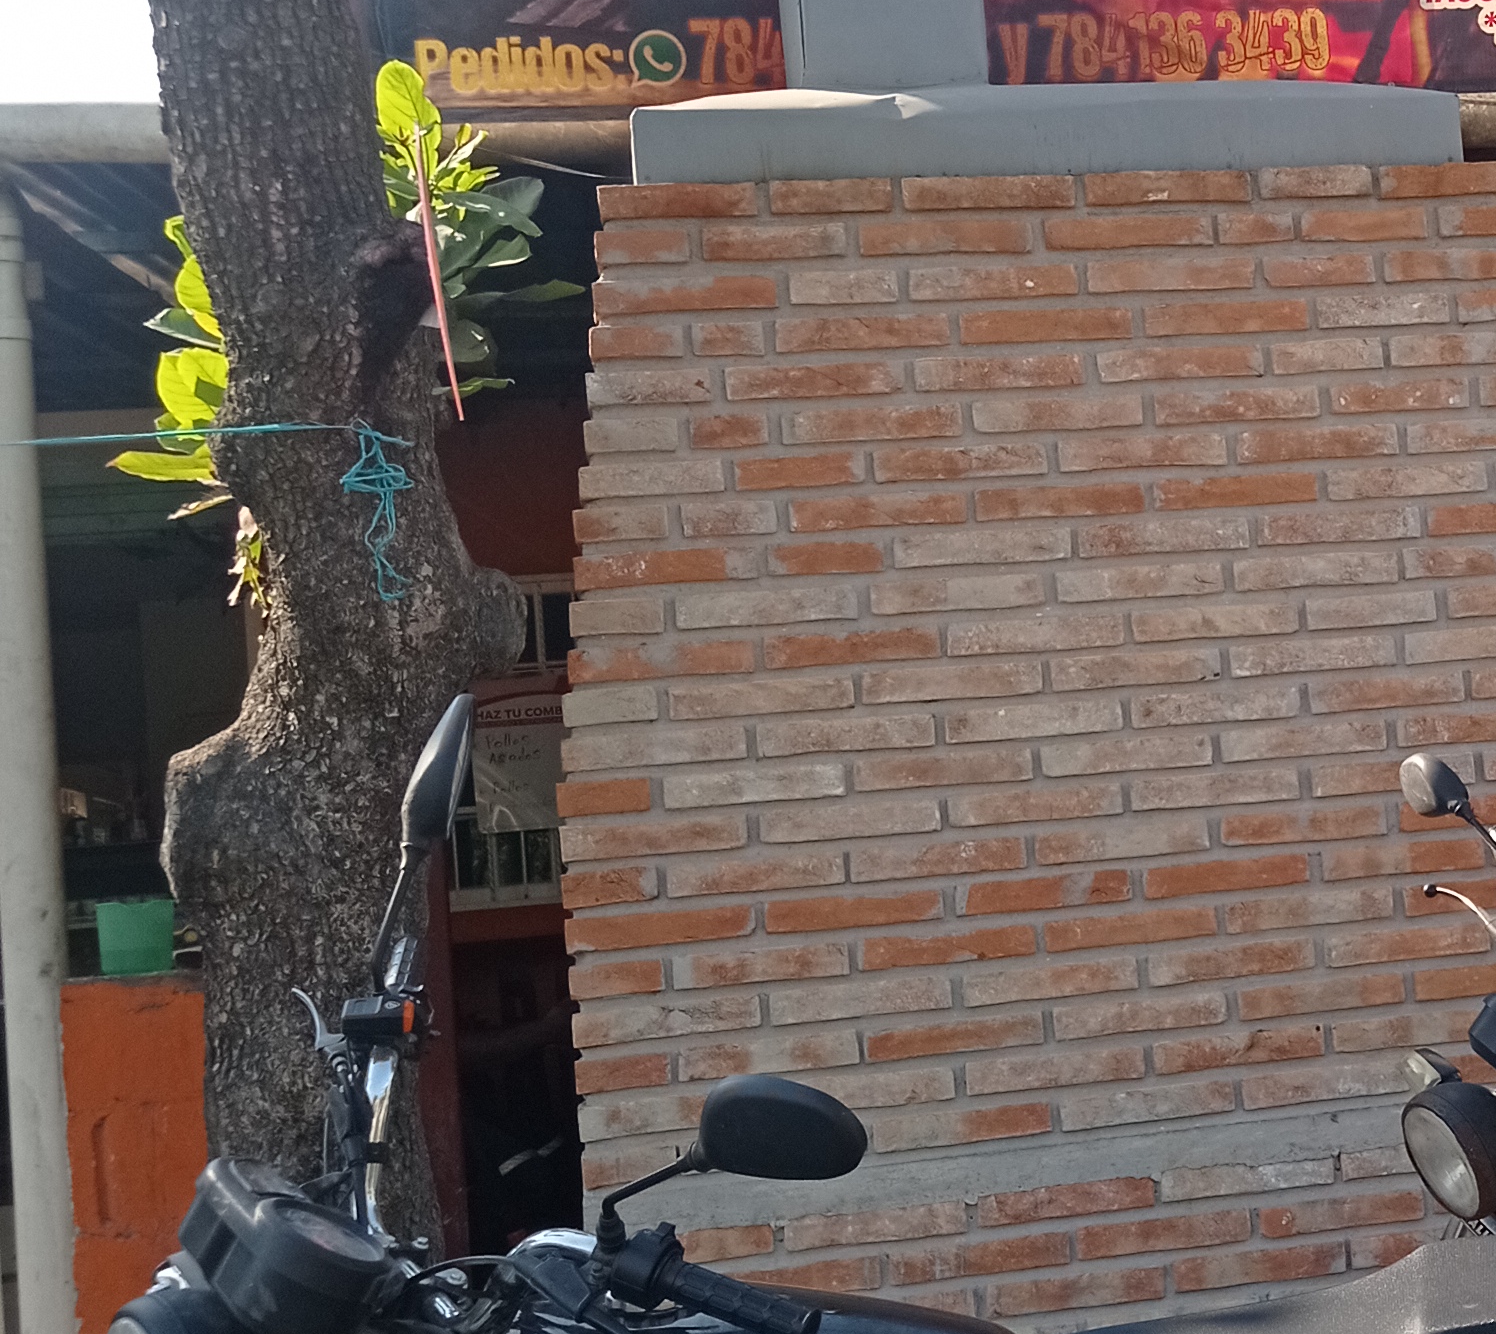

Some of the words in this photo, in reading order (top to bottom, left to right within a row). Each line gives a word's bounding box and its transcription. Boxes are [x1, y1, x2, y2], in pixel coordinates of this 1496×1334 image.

[414, 35, 625, 94] Pedidos:
[504, 708, 521, 719] TU
[524, 706, 563, 718] COMB
